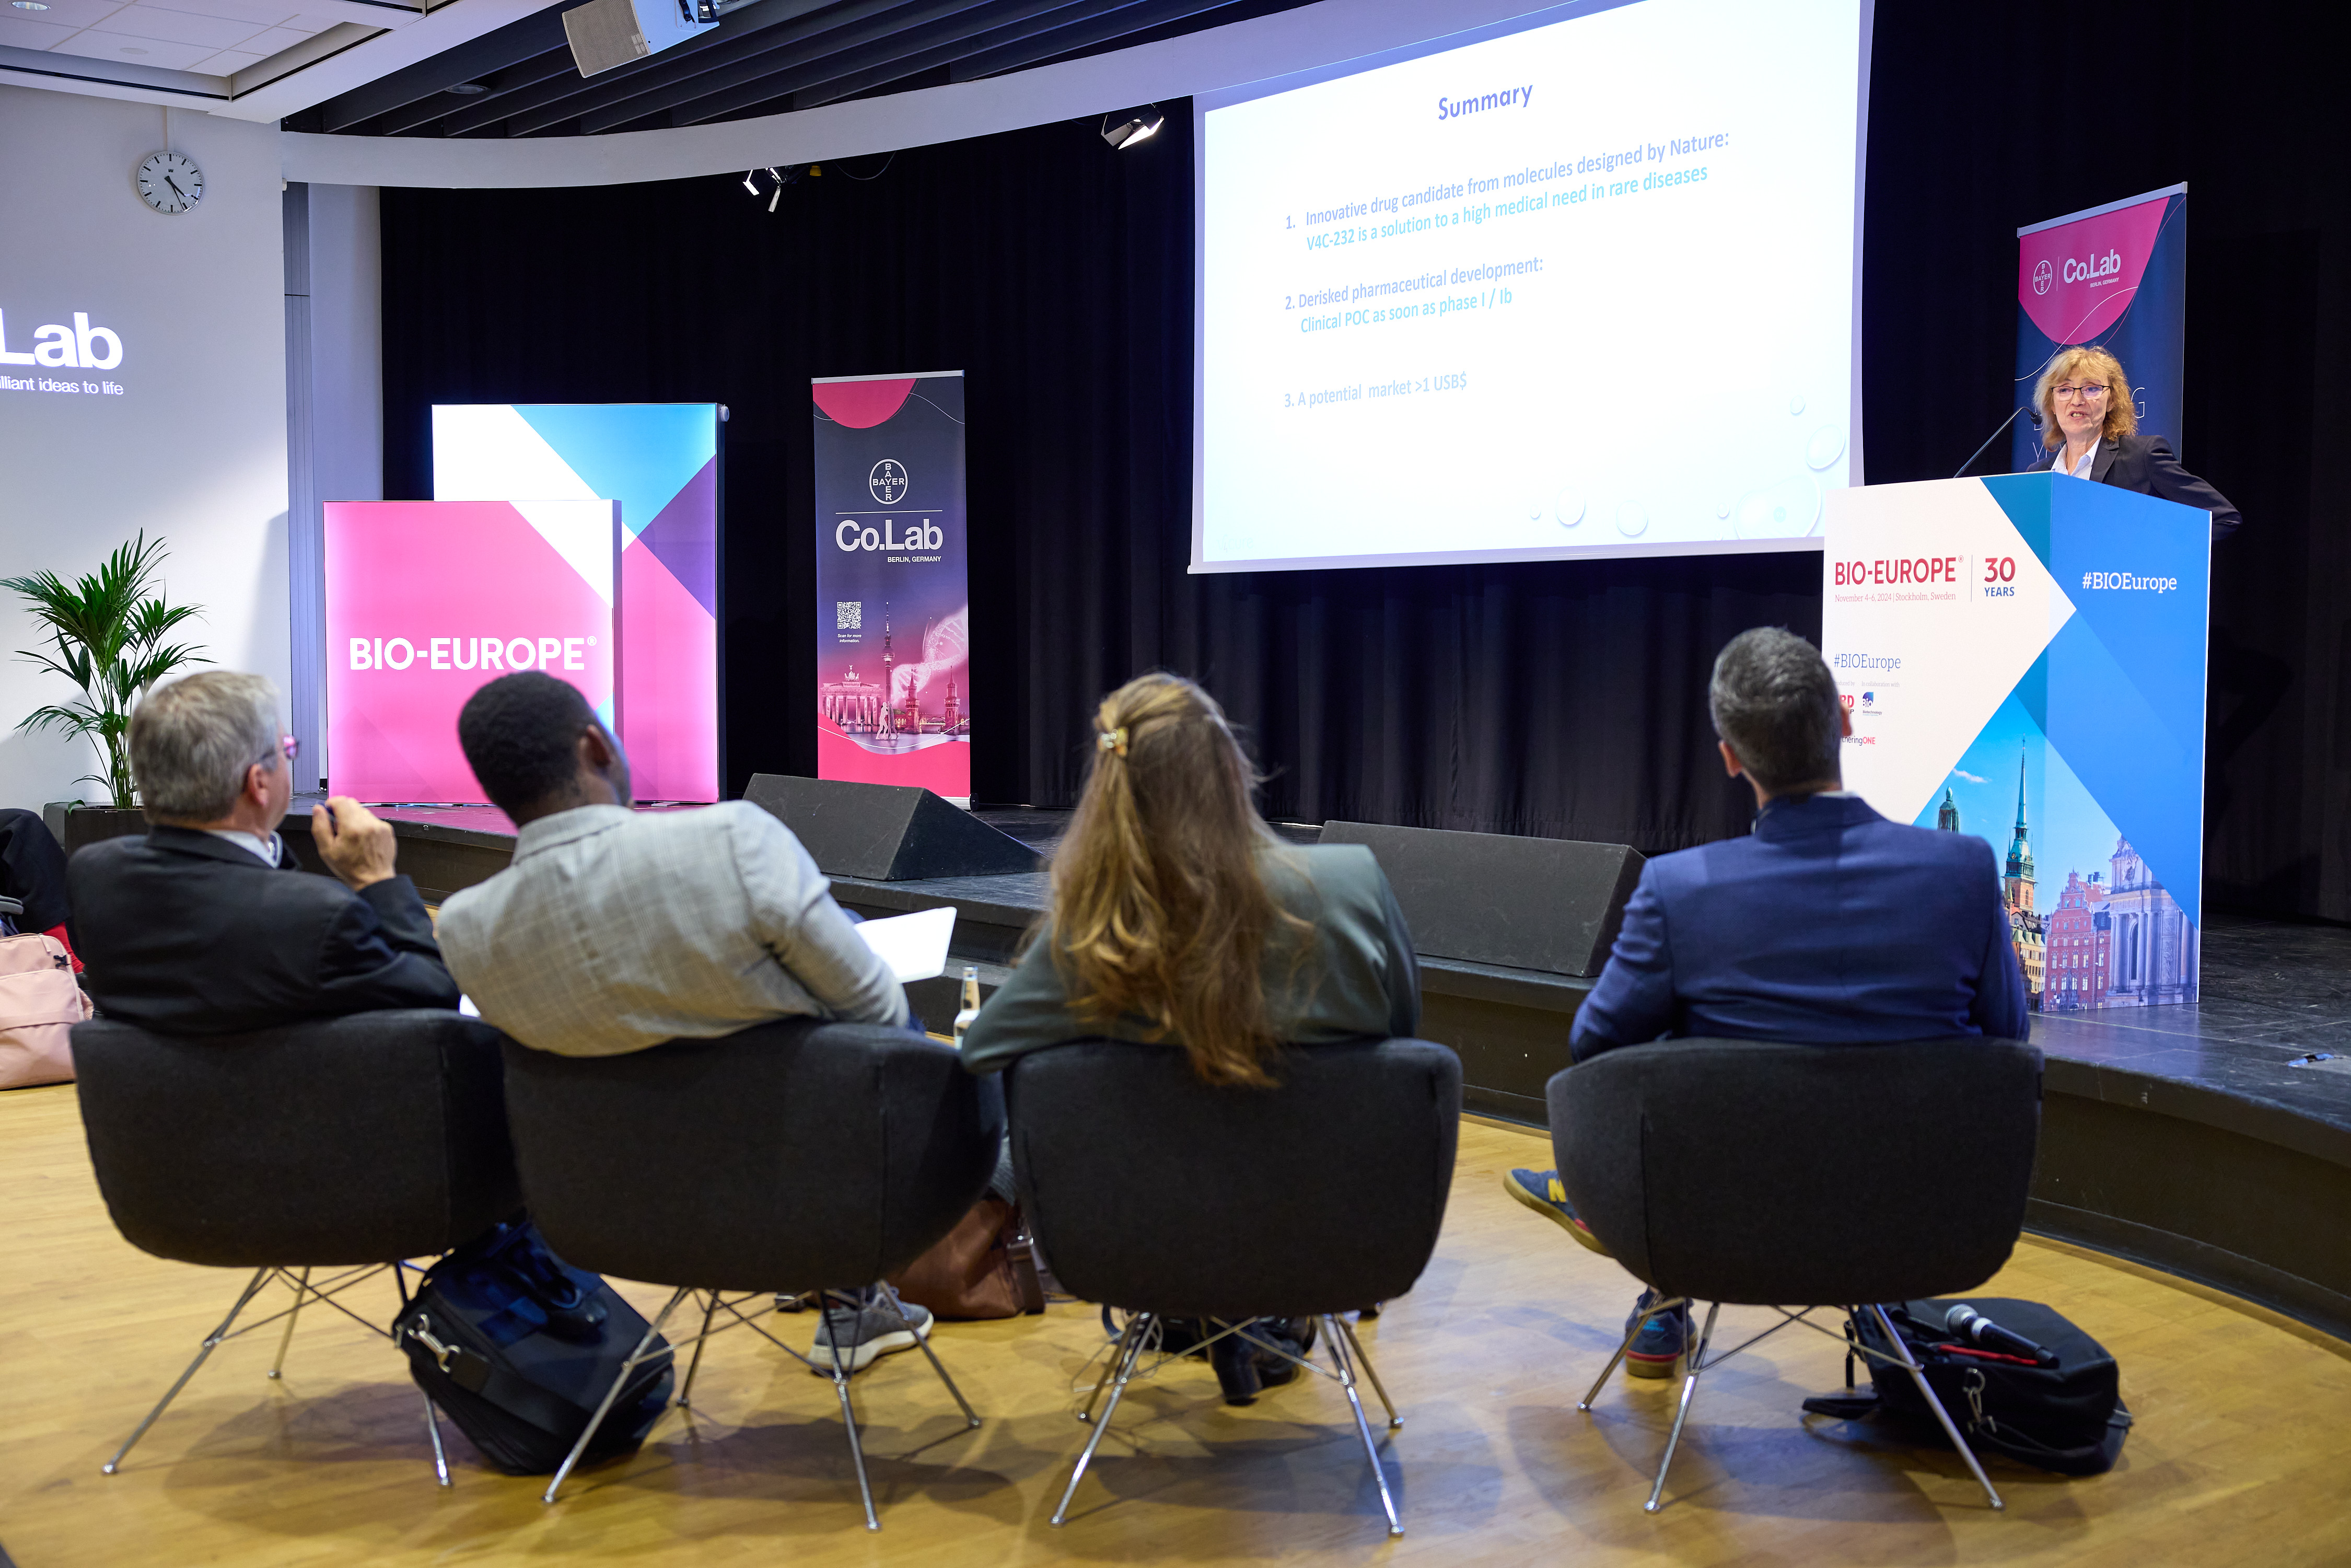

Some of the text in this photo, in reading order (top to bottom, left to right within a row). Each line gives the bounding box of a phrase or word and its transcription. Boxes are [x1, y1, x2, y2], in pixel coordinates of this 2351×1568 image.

[1438, 84, 1533, 121] Summary
[1286, 132, 1729, 230] 1. Innovative drug candidate from molecules designed by Nature:
[1306, 166, 1708, 251] V4C-232 is a solution to a high medical need in rare diseases
[2035, 273, 2051, 282] BAYER
[2064, 249, 2121, 284] Co.Lab
[1285, 257, 1543, 310] 2. Derisked pharmaceutical development:
[1301, 311, 1342, 333] Clinical
[1345, 309, 1370, 327] POC
[1372, 309, 1386, 323] as
[1389, 305, 1418, 321] soon
[1422, 302, 1436, 316] as
[1439, 296, 1477, 317] phase
[38, 377, 80, 393] ideas
[83, 380, 99, 394] to
[102, 381, 124, 395] life
[1284, 370, 1467, 409] 3. A potential market >1 USB$
[872, 478, 905, 486] BAYER
[835, 518, 944, 552] Co.Lab
[1984, 556, 2016, 583] 30
[2082, 572, 2178, 594] #BIOEurope
[1835, 594, 1864, 602] November
[1877, 593, 1892, 601] 2024
[1895, 592, 1929, 601] Stockholm,
[1930, 592, 1956, 600] Sweden
[1984, 587, 2015, 597] YEARS
[1834, 654, 1901, 672] #BIOEurope
